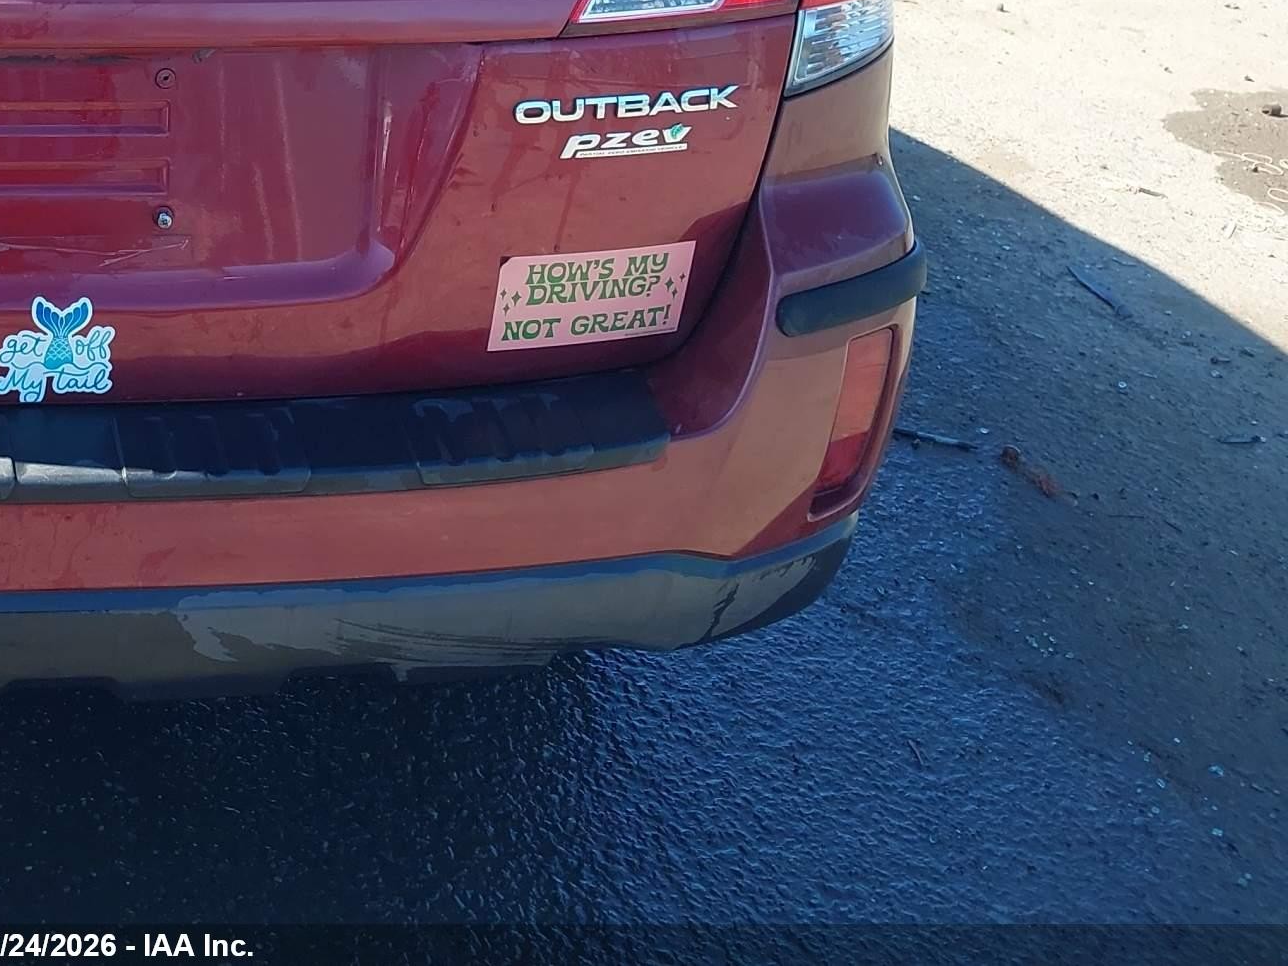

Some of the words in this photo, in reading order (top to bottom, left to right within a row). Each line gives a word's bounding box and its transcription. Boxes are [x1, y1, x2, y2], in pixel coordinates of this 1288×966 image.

[515, 85, 740, 125] OUTBACK
[525, 257, 615, 285] HOW'S
[624, 252, 669, 276] MY
[526, 275, 661, 306] DRIVING?
[501, 318, 562, 341] NOT
[570, 304, 672, 336] GREAT!
[0, 334, 47, 364] get
[75, 330, 112, 362] off
[43, 368, 109, 390] tail
